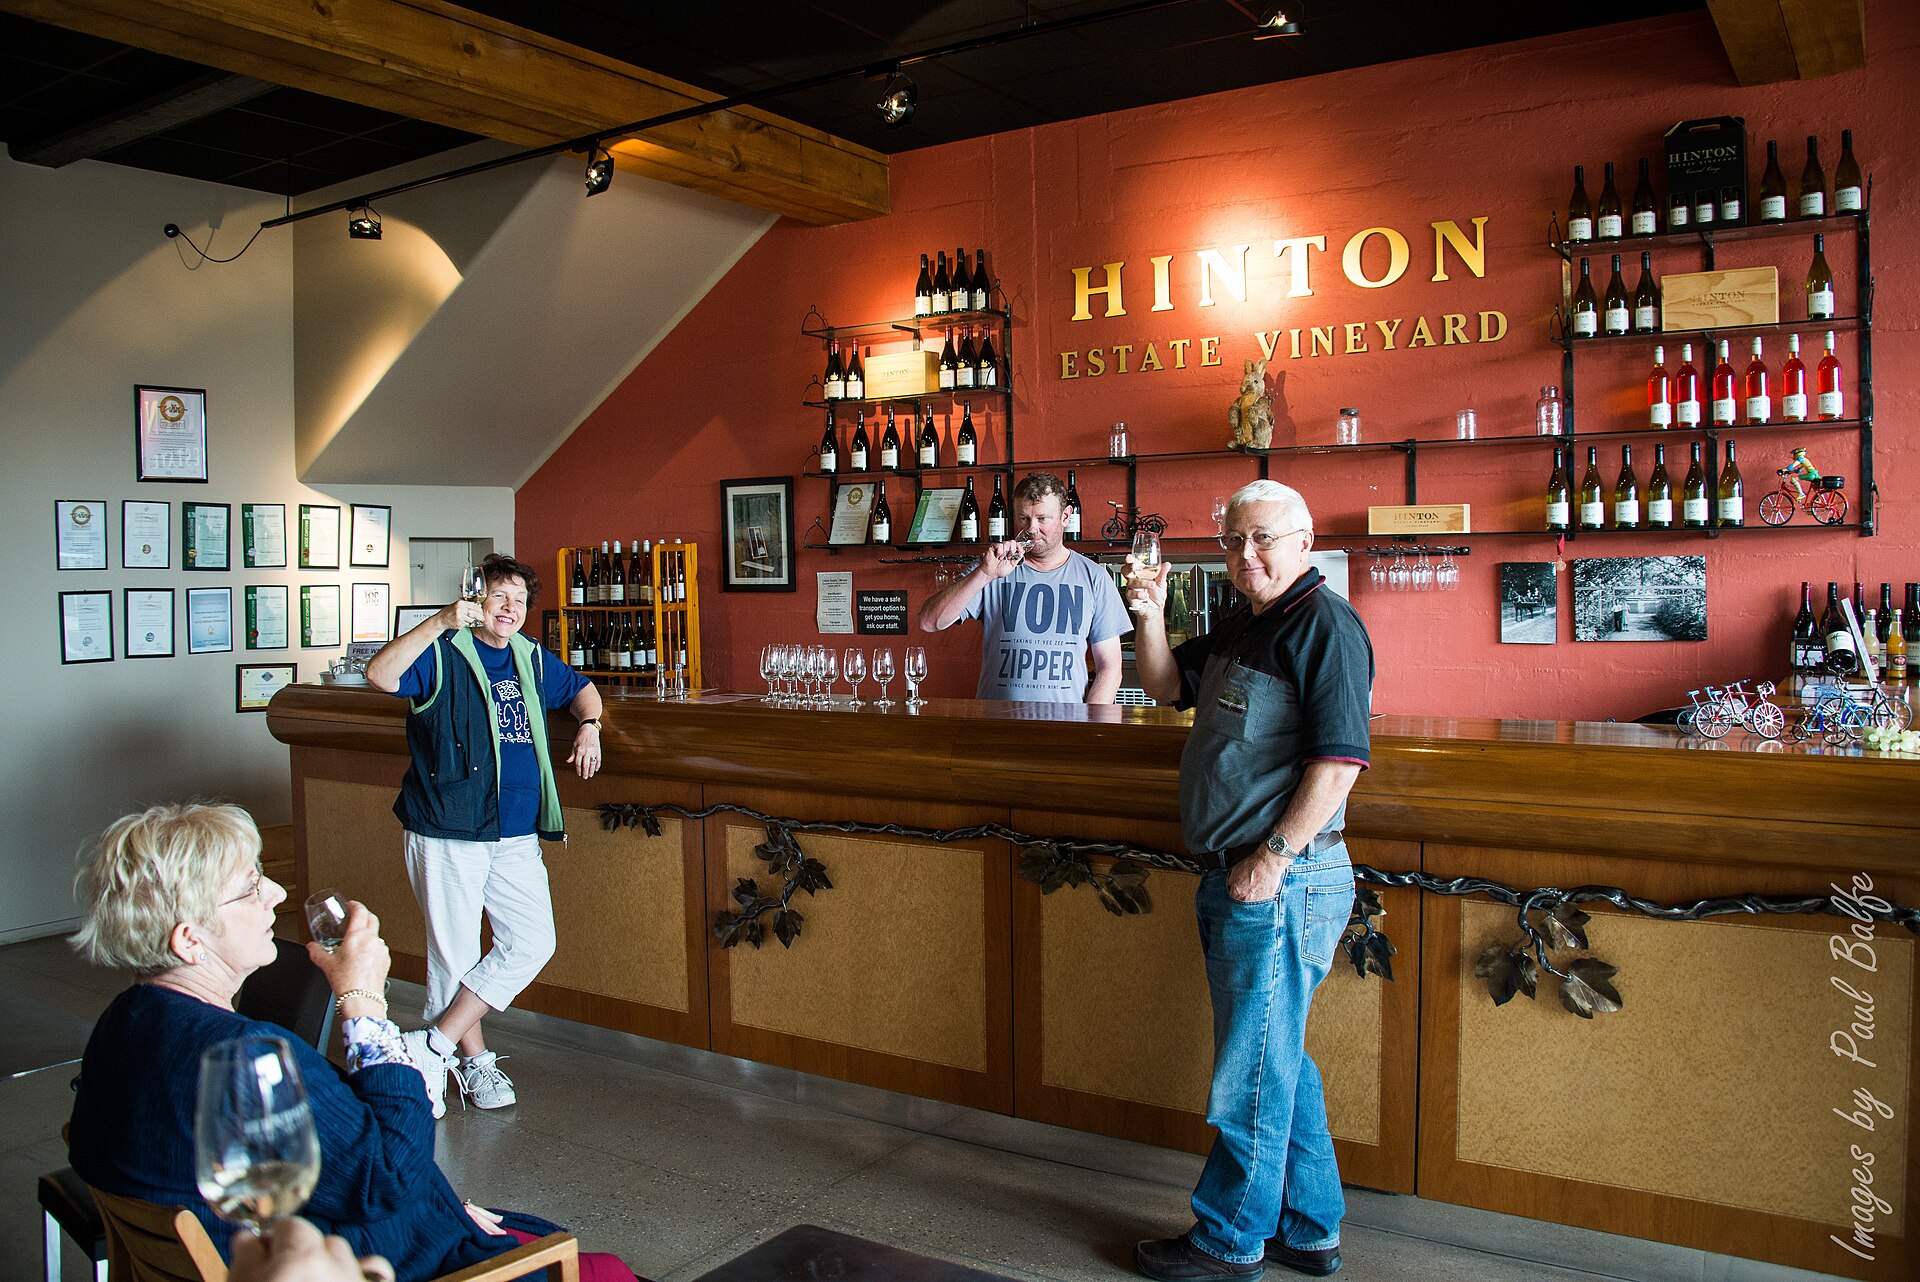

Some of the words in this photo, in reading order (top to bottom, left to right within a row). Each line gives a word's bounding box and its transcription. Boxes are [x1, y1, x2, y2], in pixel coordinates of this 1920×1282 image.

[1669, 146, 1737, 164] HINTON
[1071, 215, 1490, 322] HINTON
[1060, 336, 1222, 380] ESTATE
[1254, 310, 1510, 361] VINEYARD
[1394, 512, 1439, 520] HINTON
[859, 605, 882, 613] transport
[882, 605, 900, 613] option
[864, 614, 873, 622] get
[1001, 582, 1084, 635] VON
[998, 648, 1074, 681] ZIPPER
